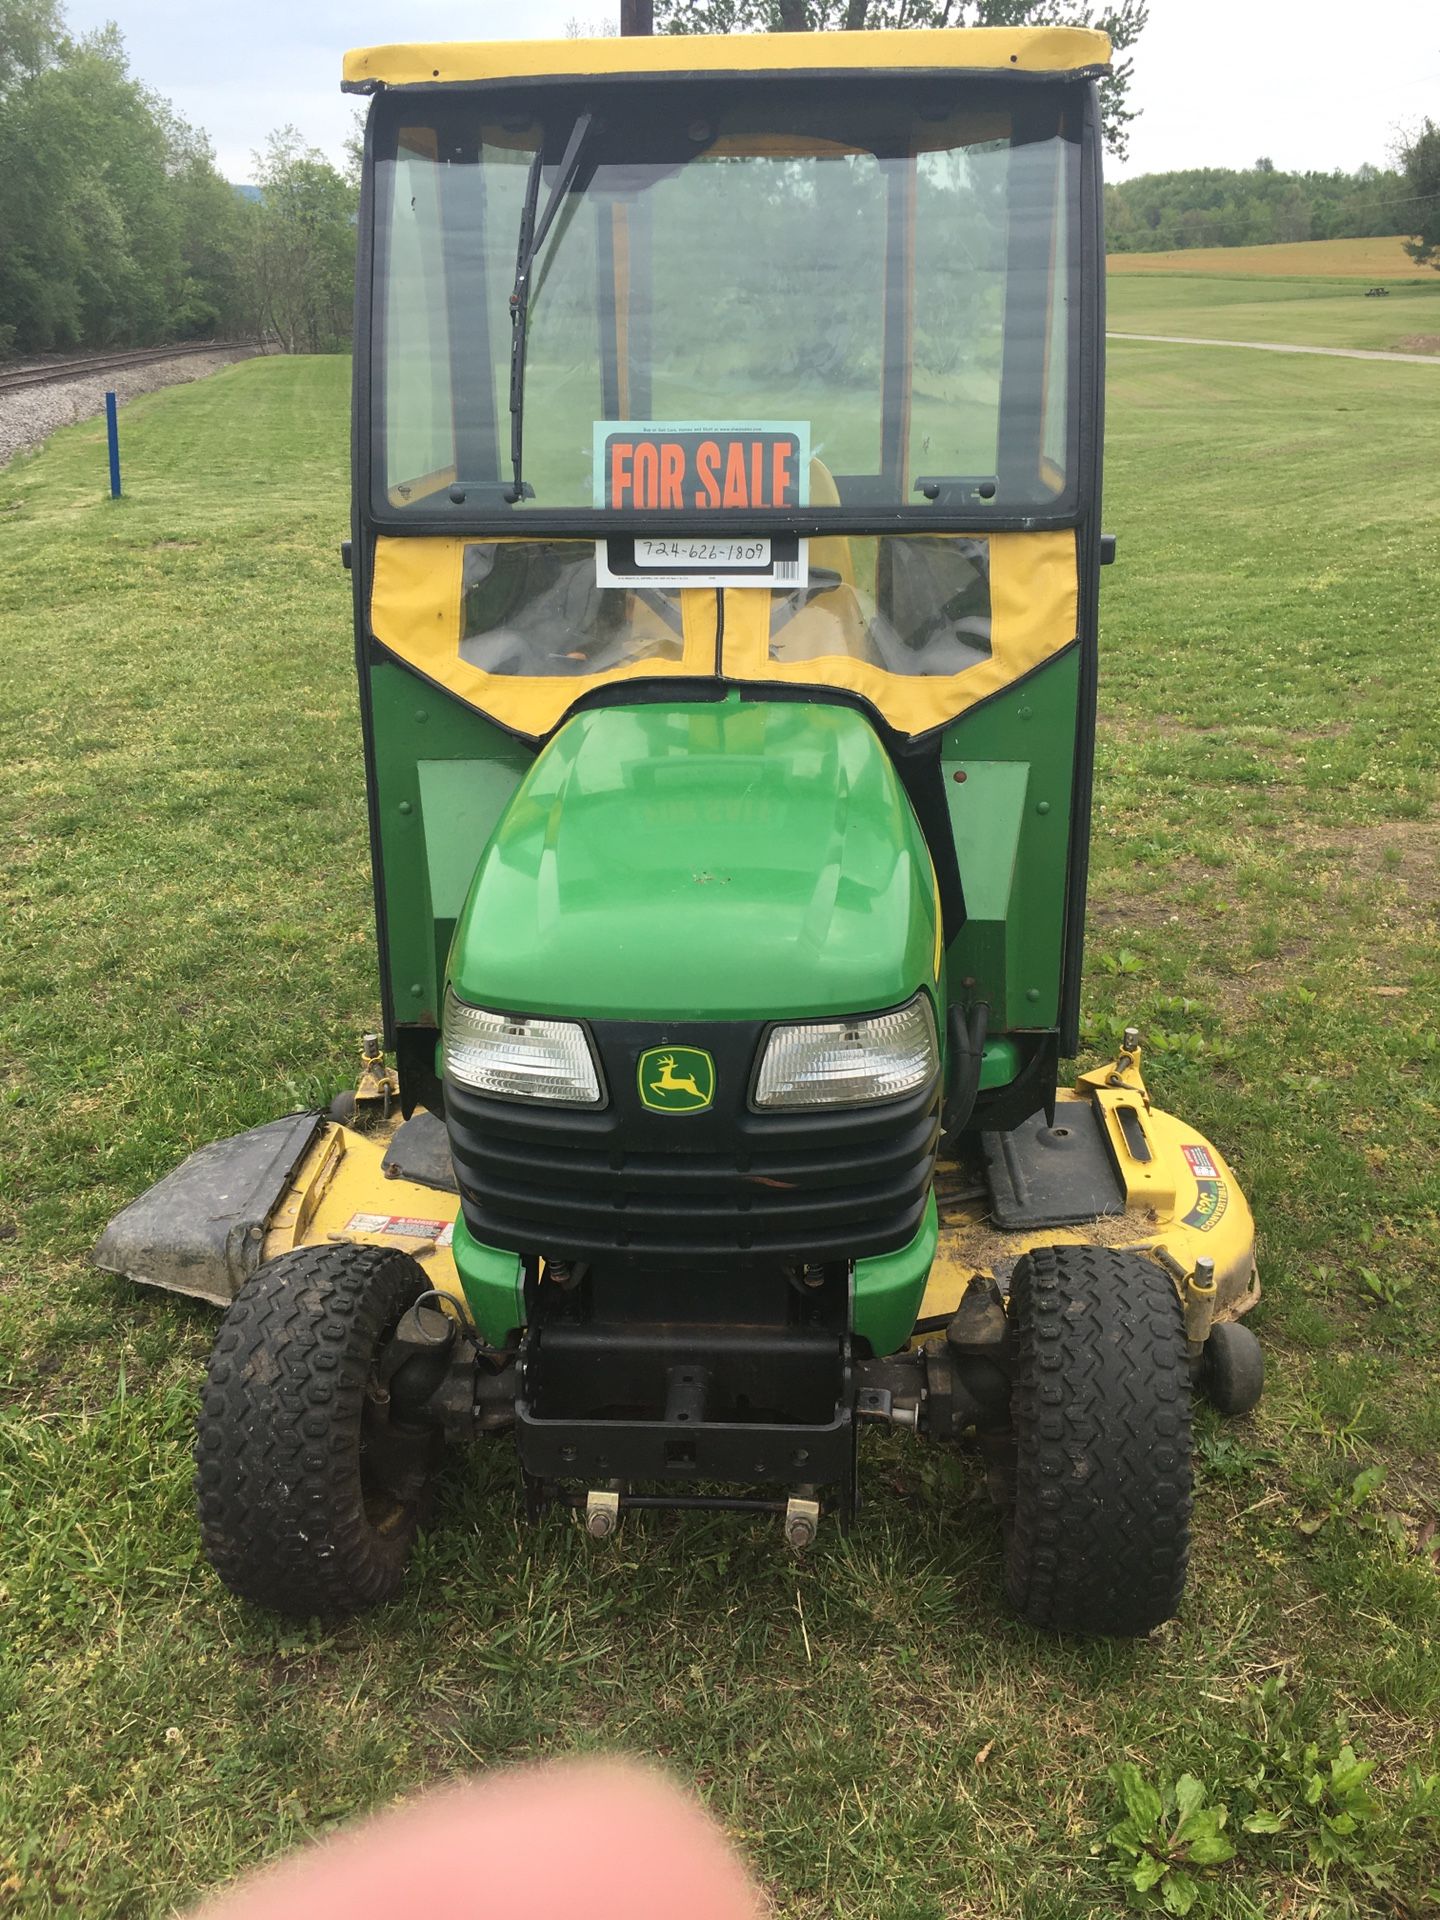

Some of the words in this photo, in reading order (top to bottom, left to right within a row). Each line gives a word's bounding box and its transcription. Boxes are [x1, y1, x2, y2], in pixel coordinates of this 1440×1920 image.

[612, 443, 685, 510] FOR
[695, 441, 792, 509] SALE
[643, 541, 763, 560] 724-626-1809
[1196, 1192, 1217, 1215] 62C
[1201, 1181, 1227, 1231] CONVERTIBLE
